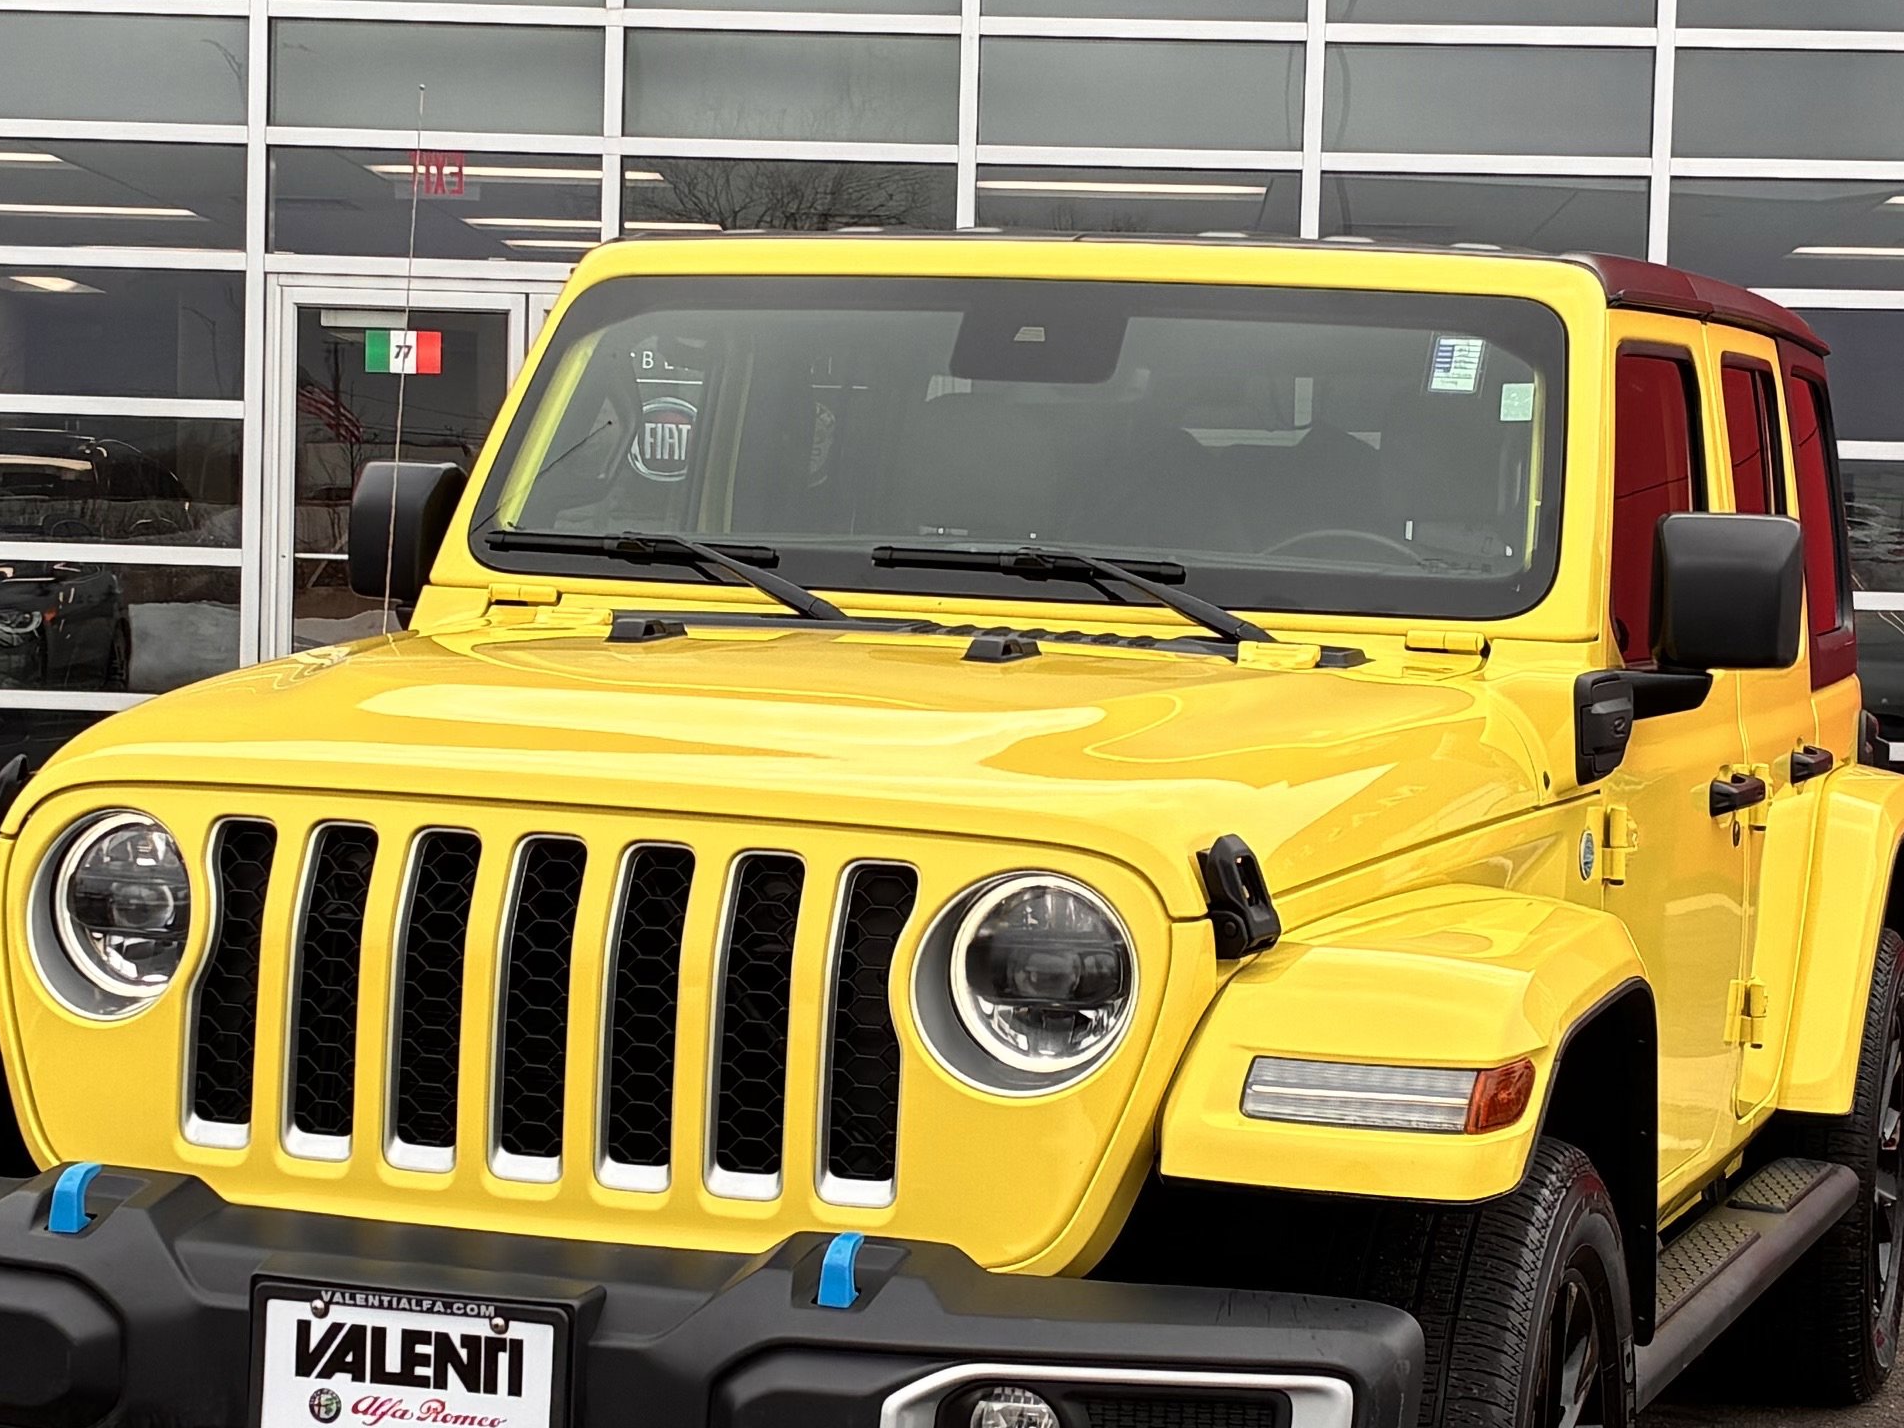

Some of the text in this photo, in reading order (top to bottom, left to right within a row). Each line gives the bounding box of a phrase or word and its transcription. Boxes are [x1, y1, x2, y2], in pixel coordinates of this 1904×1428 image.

[394, 344, 413, 359] 77
[645, 423, 692, 461] FIAT
[321, 1290, 495, 1317] VALENTIALFA.COM
[295, 1319, 523, 1398] VALENTI
[352, 1395, 413, 1426] Alfa
[416, 1398, 507, 1428] Romeo
